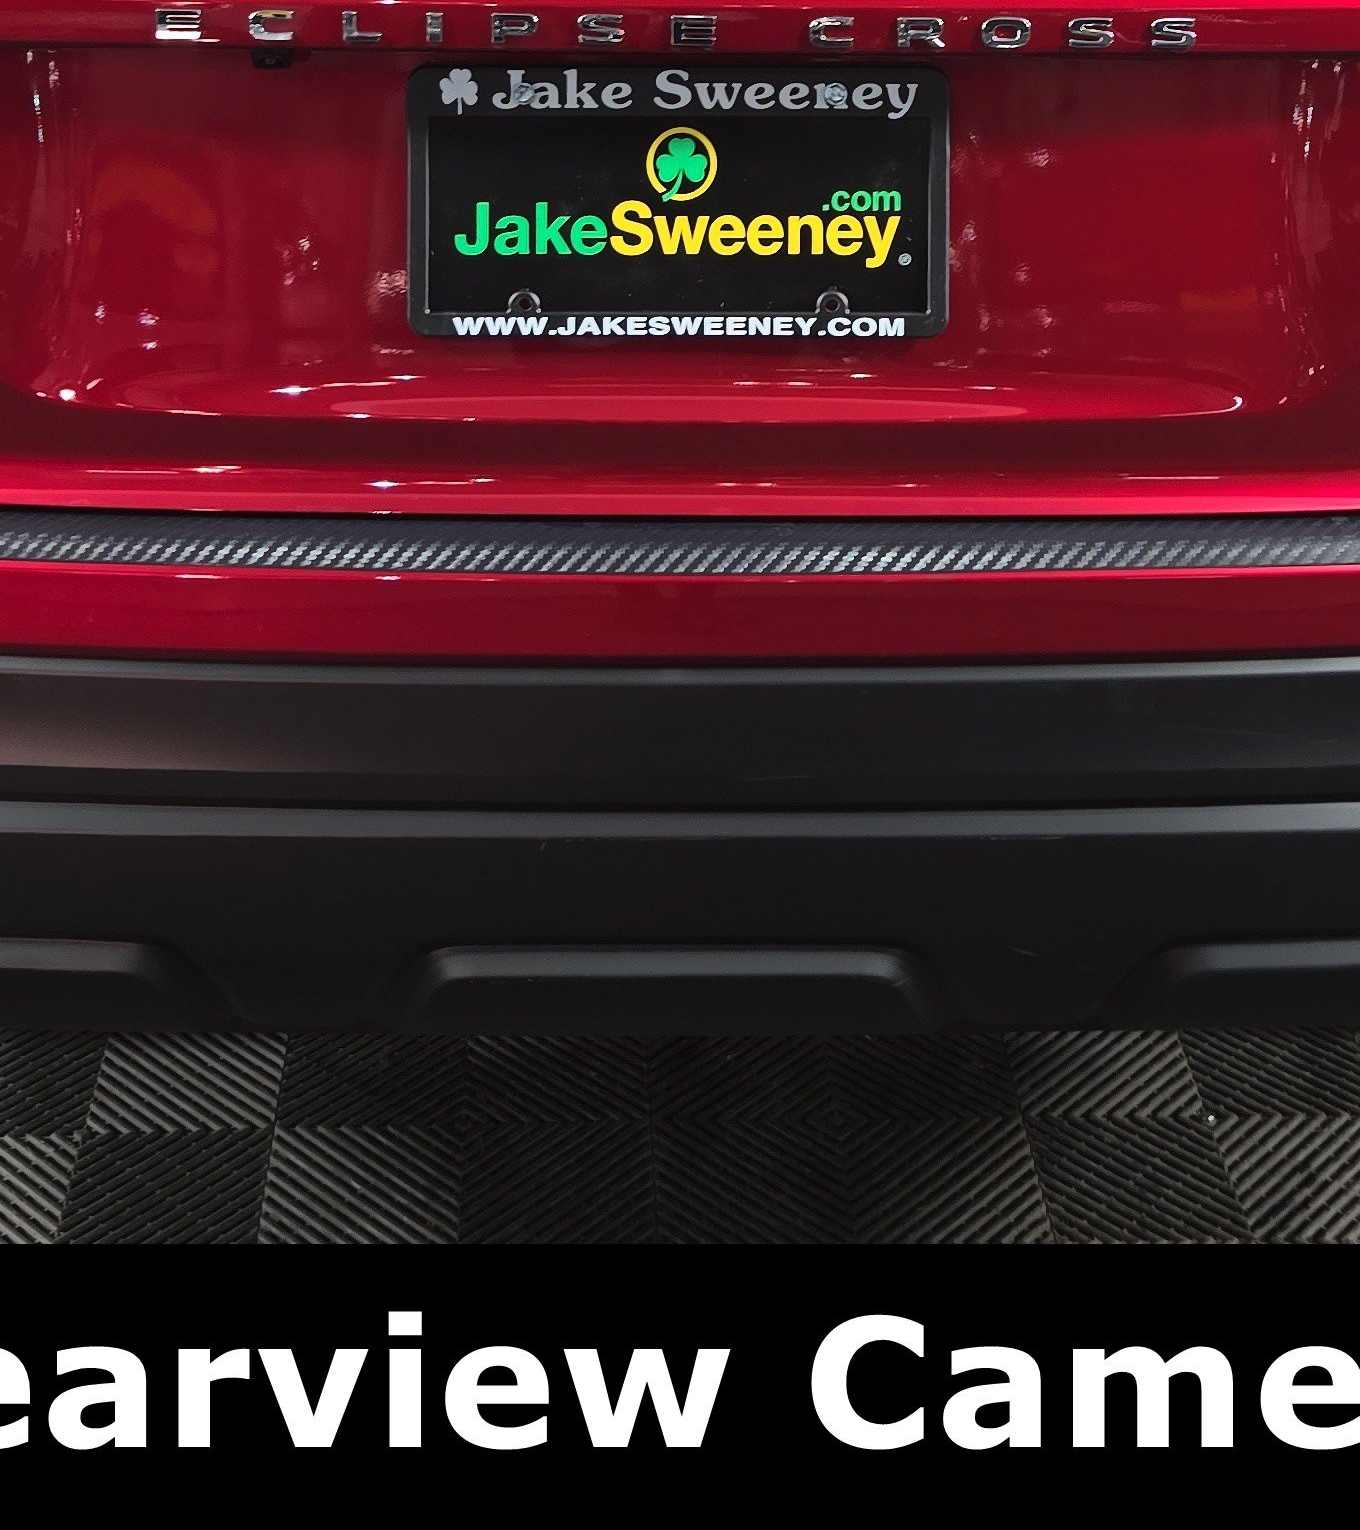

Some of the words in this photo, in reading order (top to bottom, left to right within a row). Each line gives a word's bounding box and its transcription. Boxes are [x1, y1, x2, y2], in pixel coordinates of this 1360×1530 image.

[153, 7, 718, 48] ECLIPSE
[808, 17, 1198, 50] CROSS
[492, 69, 633, 111] Jake
[653, 69, 919, 119] Sweeney
[454, 200, 901, 268] JakeSweeney
[452, 316, 905, 337] WWW.JAKESWEENEY.COM
